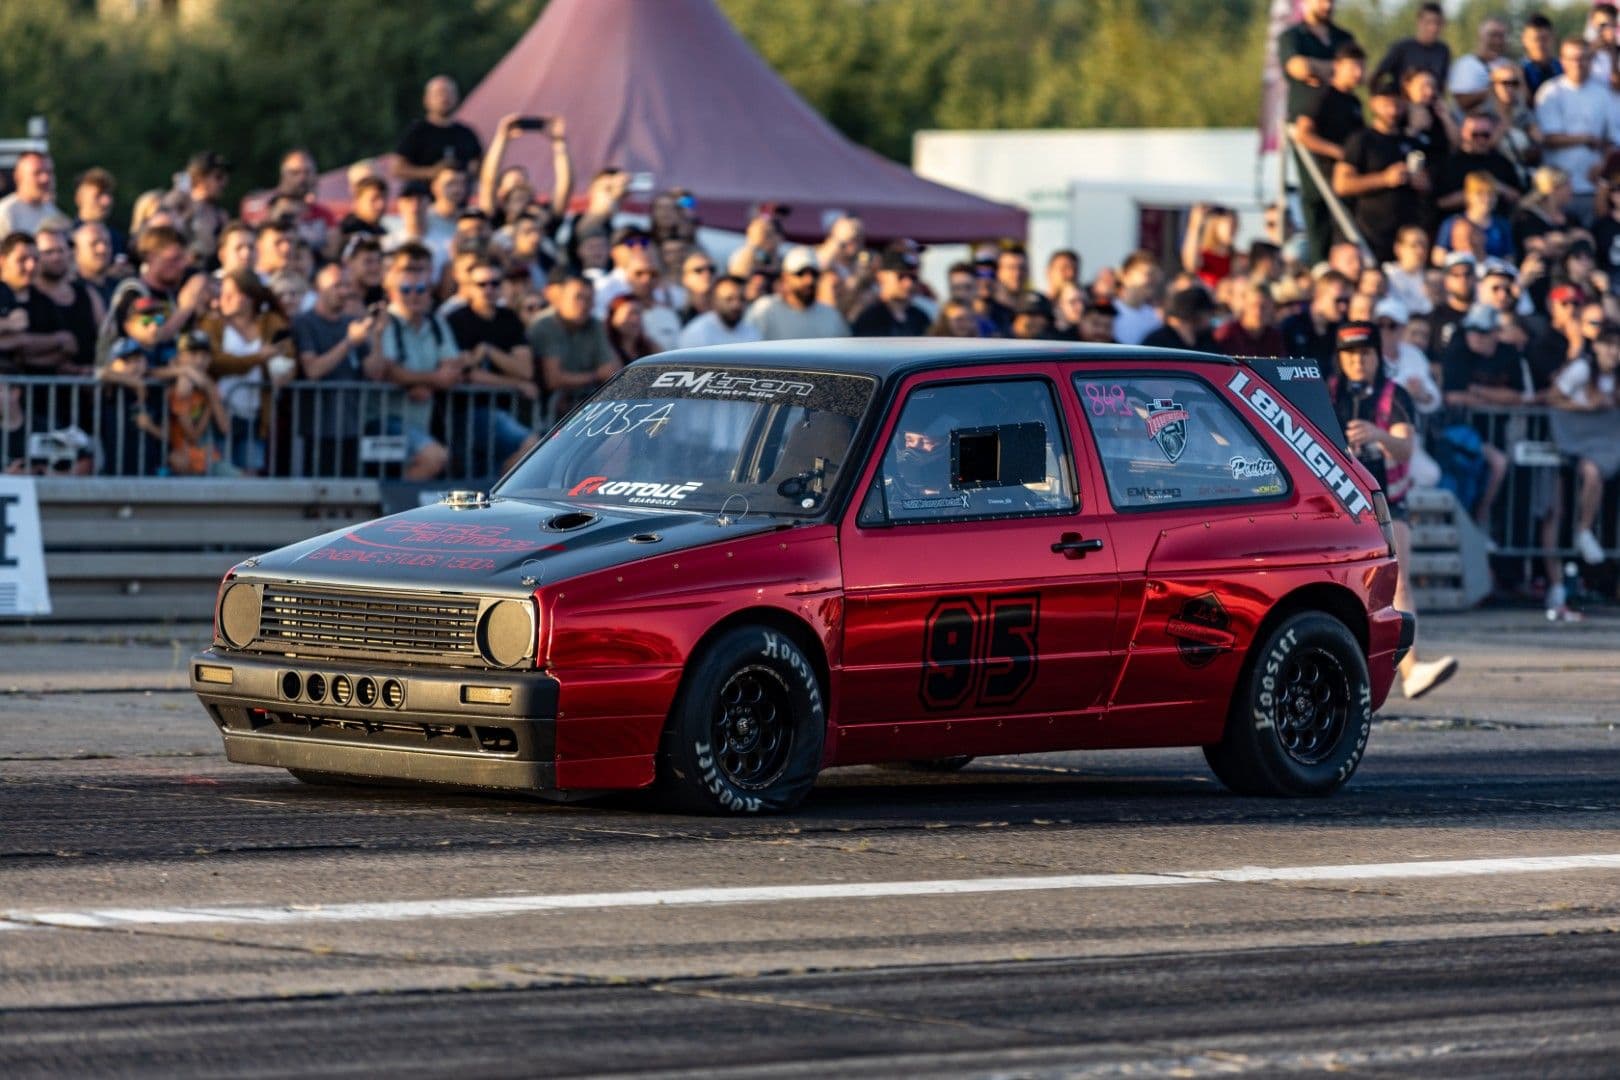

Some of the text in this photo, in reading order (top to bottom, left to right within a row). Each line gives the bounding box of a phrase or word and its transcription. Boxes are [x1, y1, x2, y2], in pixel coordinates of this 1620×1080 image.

[1293, 366, 1321, 379] JHB
[1227, 371, 1372, 516] L8NIGHT
[918, 591, 1041, 713] 95
